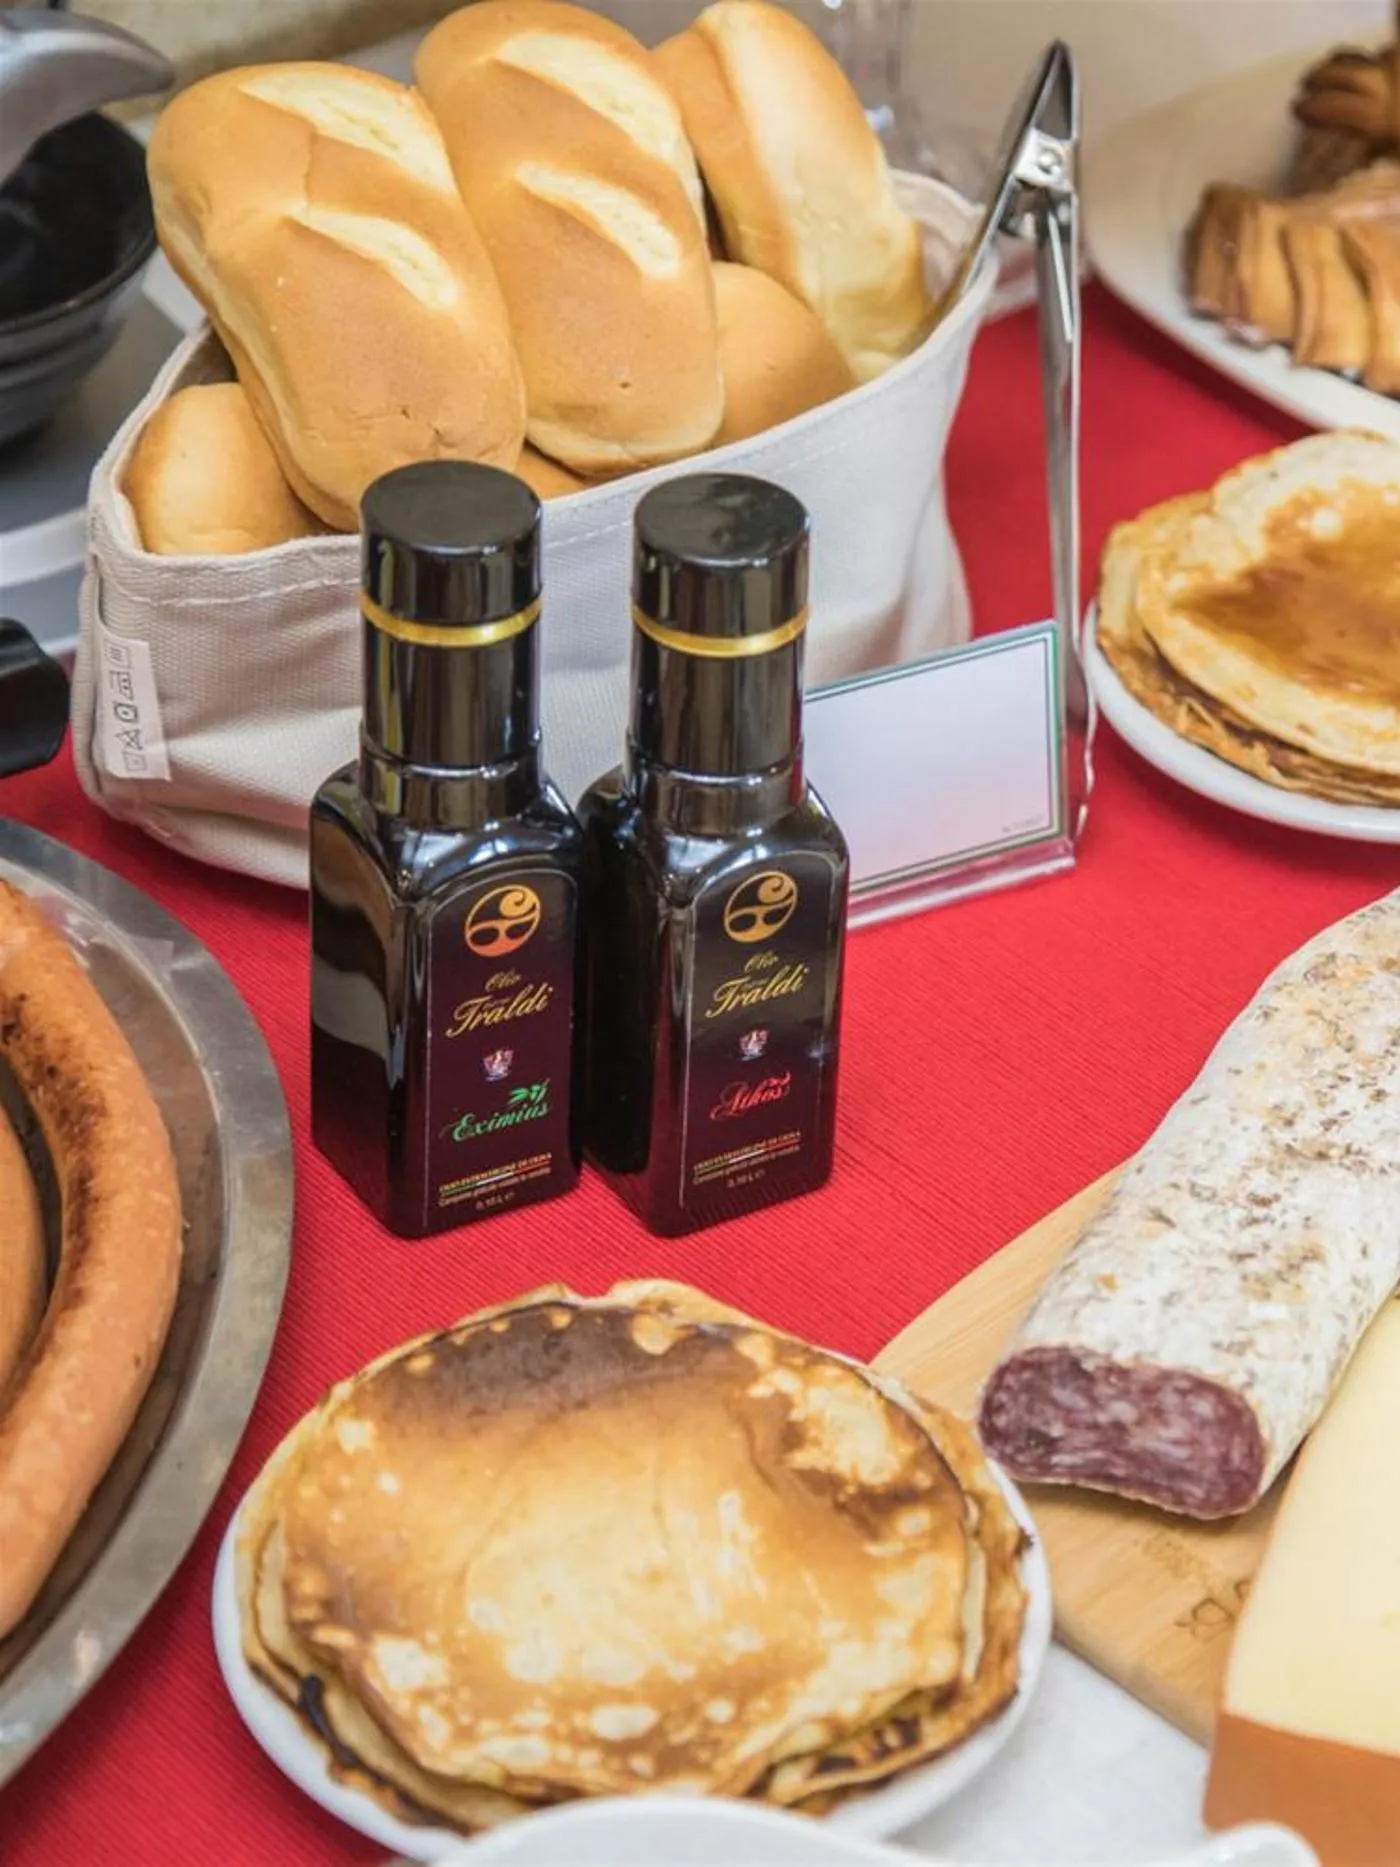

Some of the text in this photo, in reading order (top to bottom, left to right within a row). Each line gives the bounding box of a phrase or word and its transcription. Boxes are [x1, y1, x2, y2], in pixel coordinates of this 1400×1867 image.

[445, 982, 553, 1038] Traldi
[705, 963, 810, 1018] Traldi
[446, 1098, 549, 1142] Eximius
